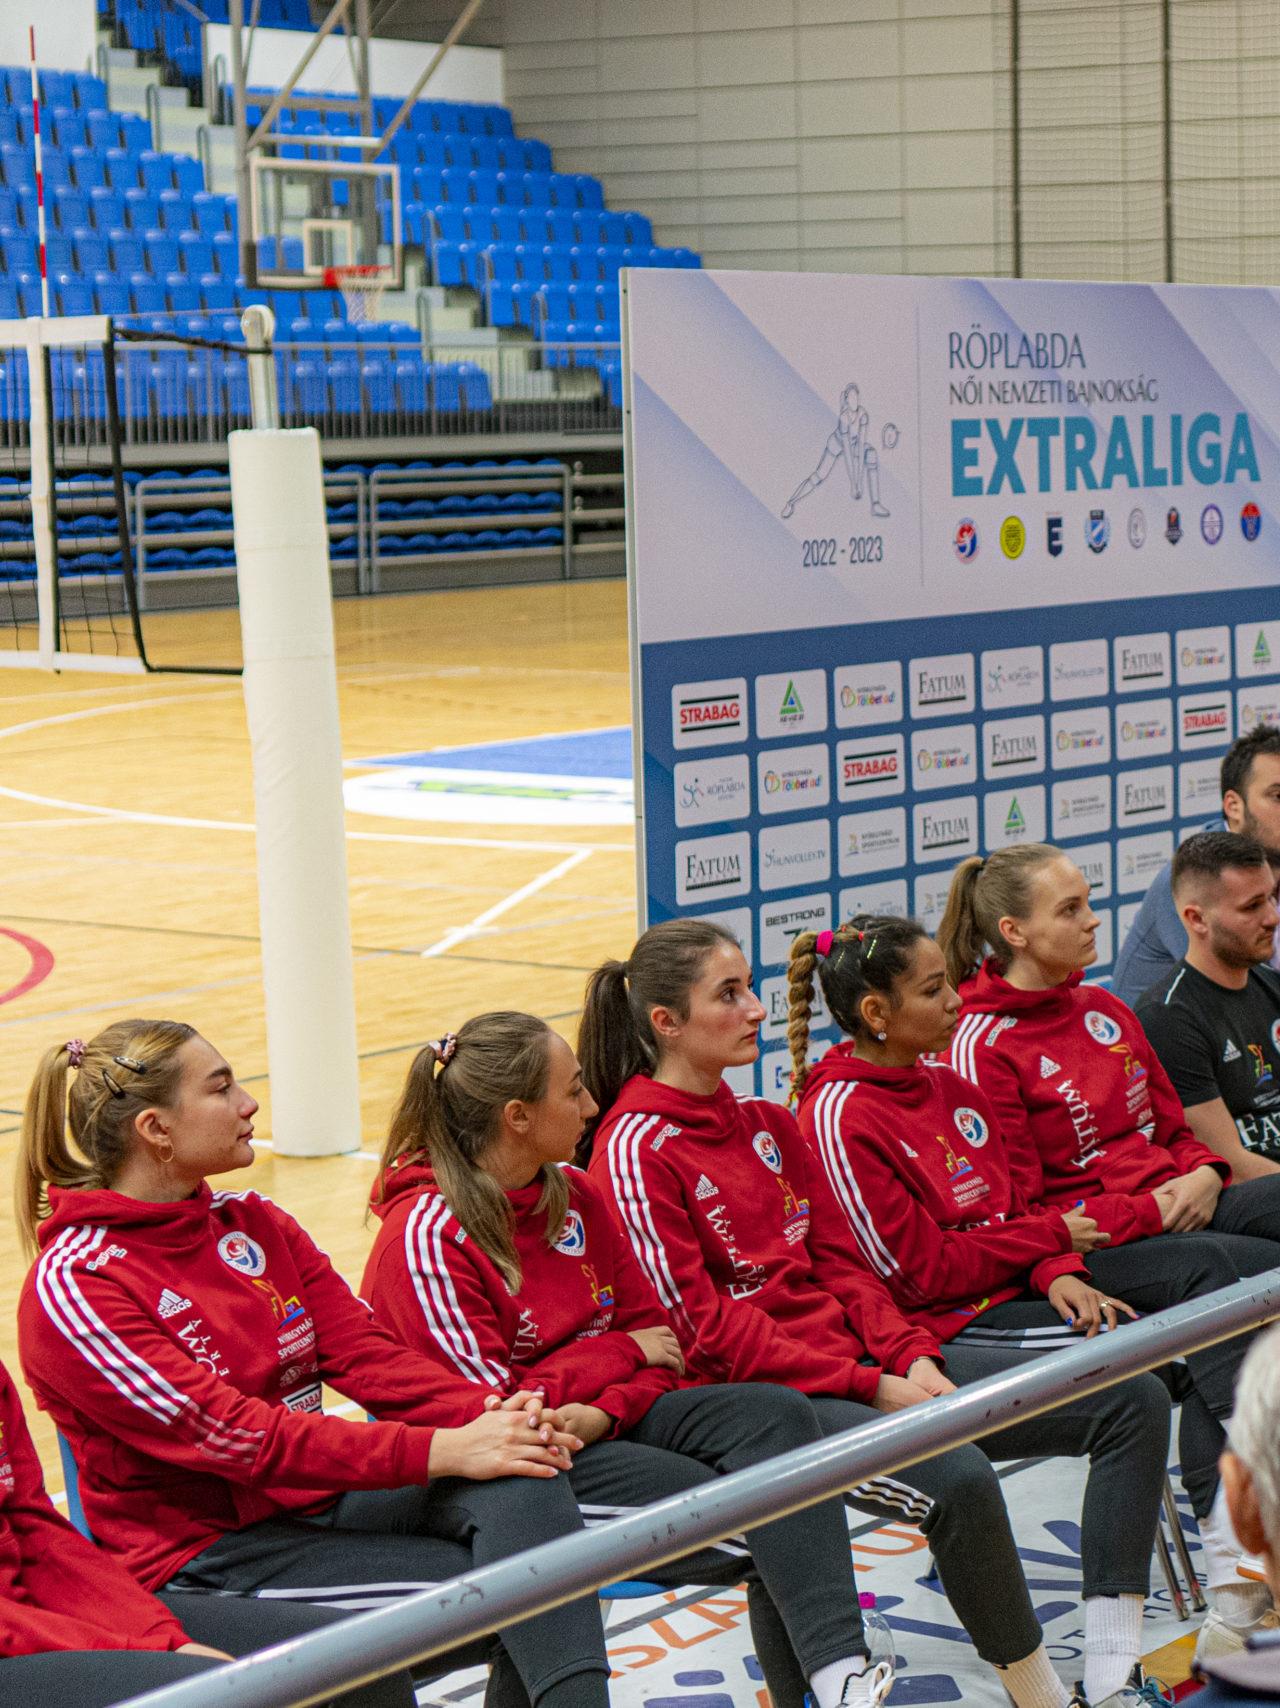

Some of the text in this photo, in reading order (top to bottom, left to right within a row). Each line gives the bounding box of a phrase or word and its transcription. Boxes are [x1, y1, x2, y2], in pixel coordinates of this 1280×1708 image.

[948, 324, 1086, 370] RÖPLABDA
[948, 375, 1160, 405] NŐI NEMZETI BAJNOKSÁG
[951, 411, 1262, 497] EXTRALIGA
[803, 538, 836, 568] 2022
[849, 535, 884, 565] 2023
[1122, 648, 1164, 670] FATUM
[918, 671, 966, 694] FATUM
[680, 702, 740, 725] STRABAG
[992, 733, 1037, 756] FATUM
[844, 757, 898, 779] STRABAG
[1124, 783, 1166, 805] FATUM
[922, 816, 969, 839] FATUM
[686, 853, 741, 878] FATUM
[766, 907, 825, 927] BESTRONG
[159, 1298, 192, 1319] adidas
